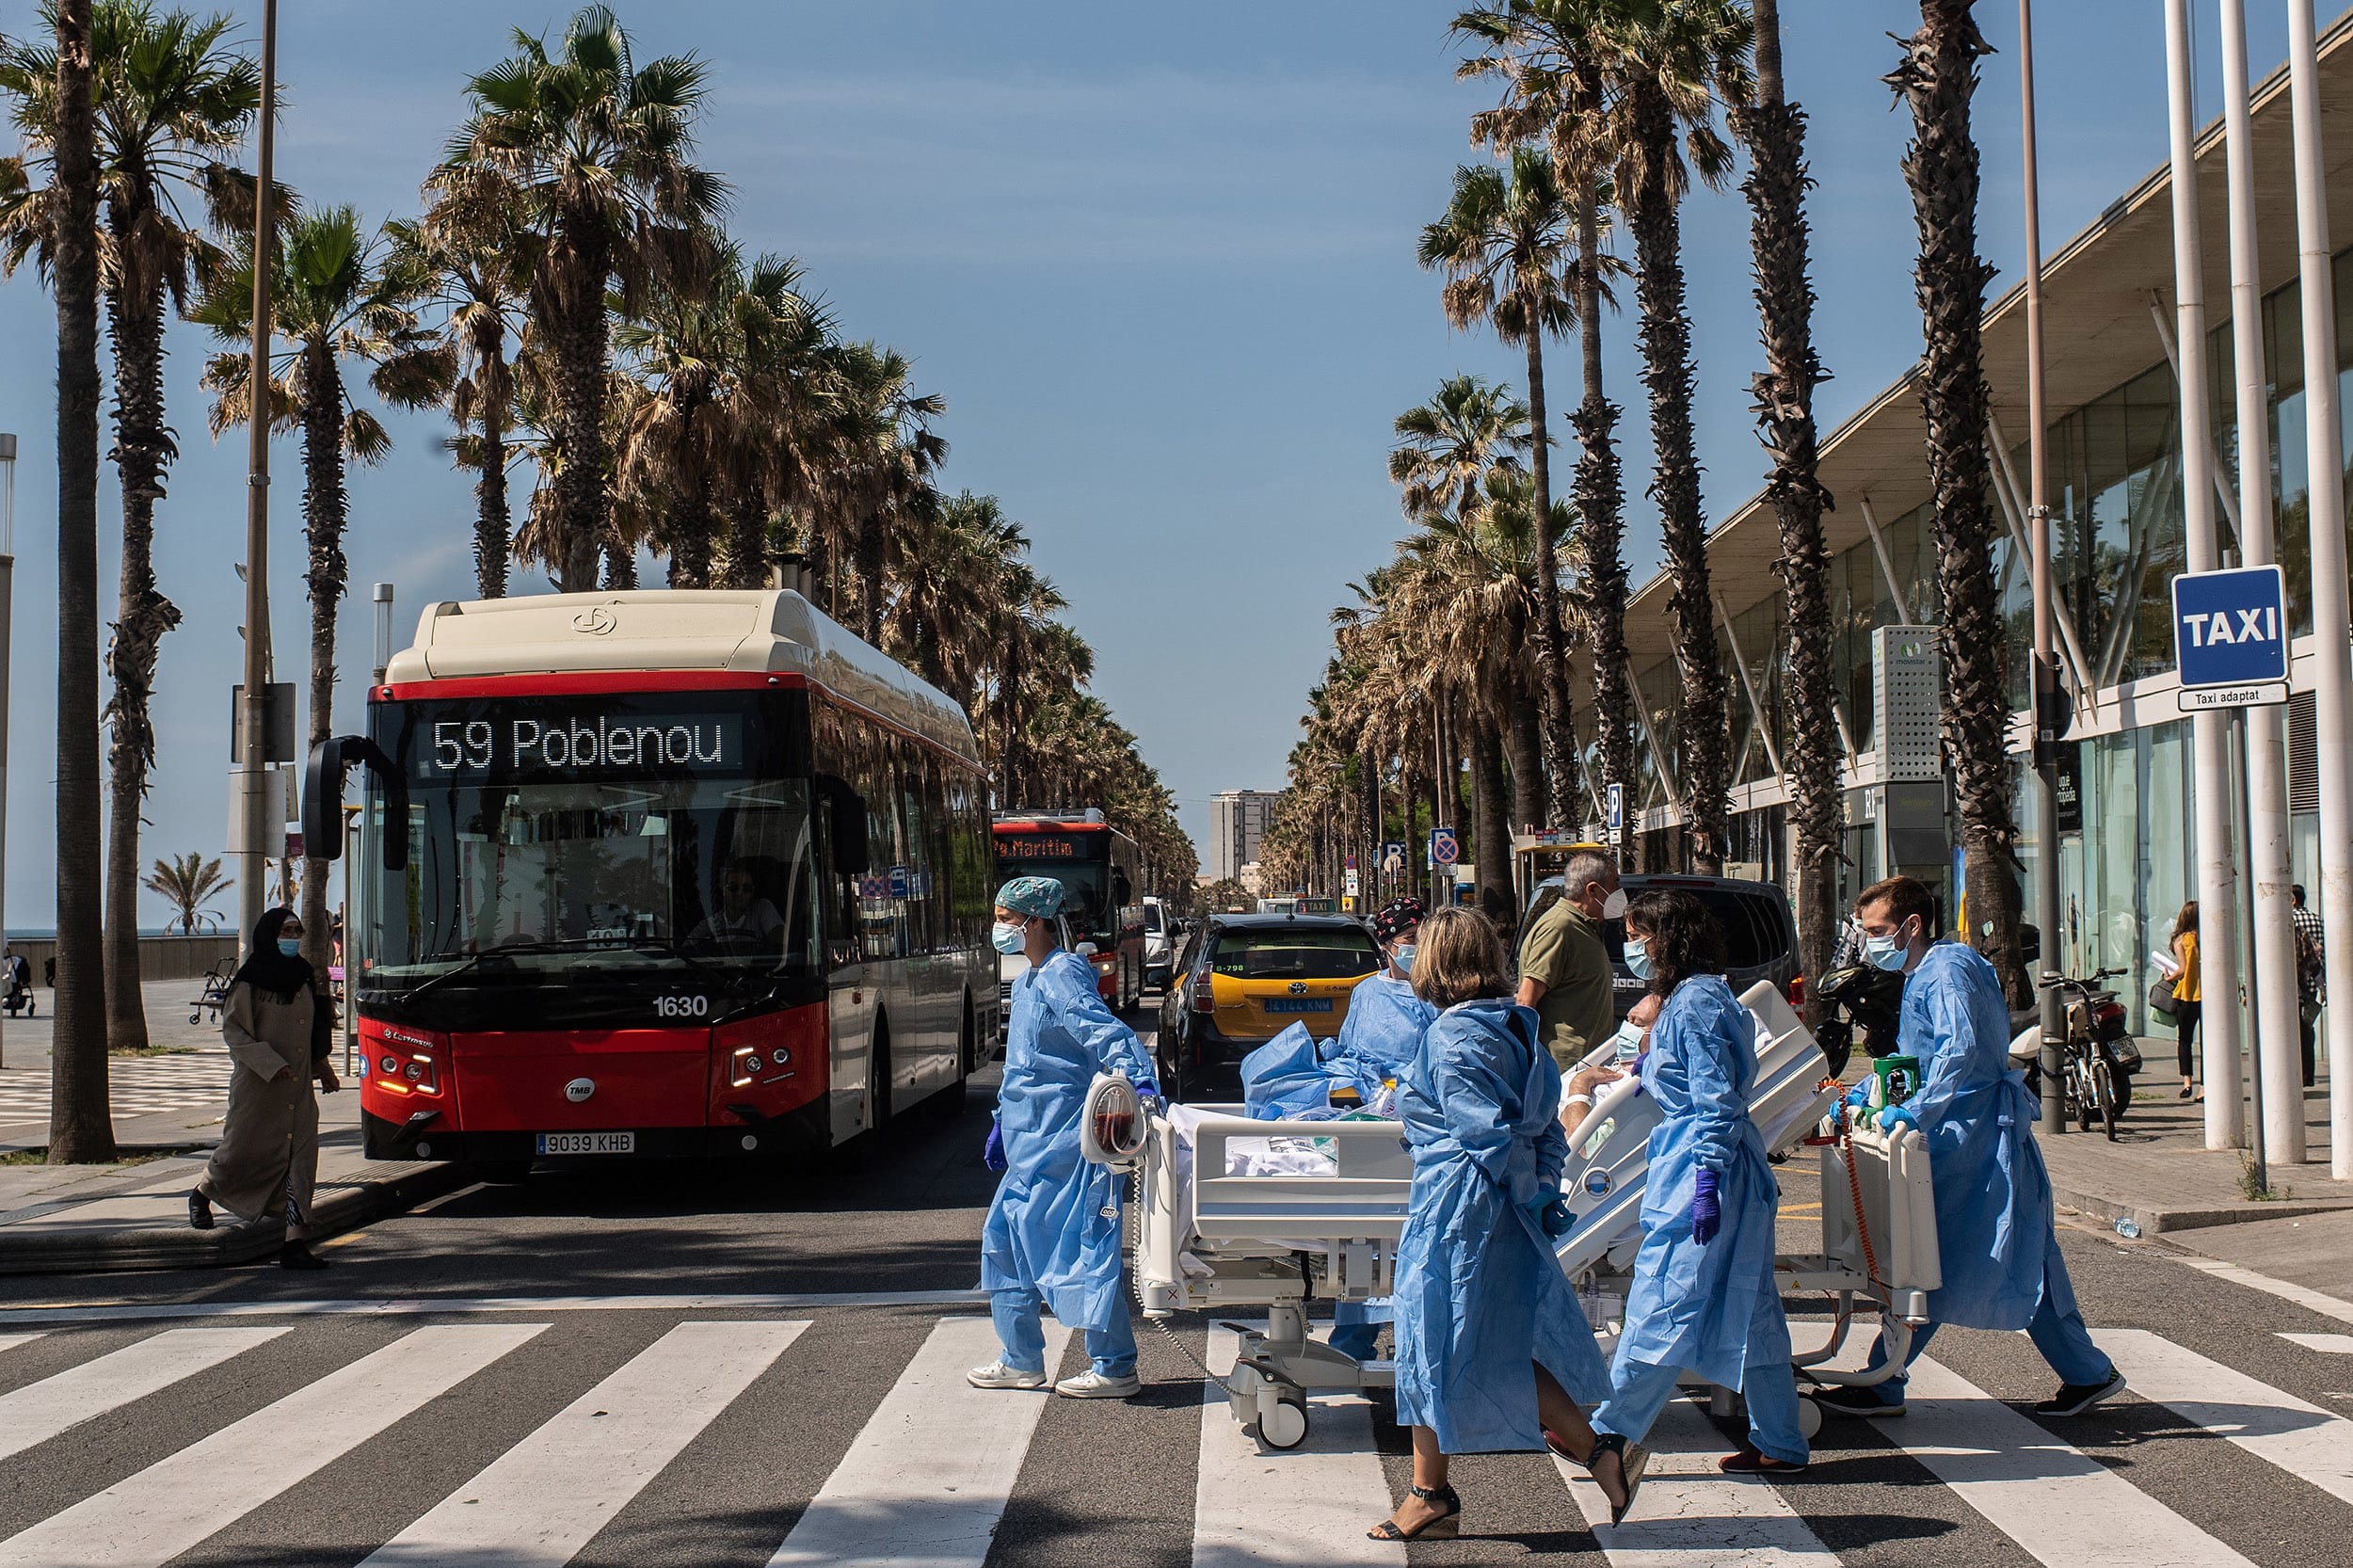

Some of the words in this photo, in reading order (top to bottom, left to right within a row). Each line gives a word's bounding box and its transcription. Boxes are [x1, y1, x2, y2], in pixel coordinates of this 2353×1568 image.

[2183, 607, 2277, 648] TAXI
[2196, 693, 2217, 704] Taxi
[2220, 691, 2260, 703] adaptat
[435, 721, 492, 769] 59
[513, 715, 722, 768] Poblenou
[1610, 790, 1619, 824] P
[1308, 903, 1327, 912] TAXI
[652, 996, 708, 1016] 1630
[549, 1136, 592, 1152] 9039
[598, 1134, 631, 1151] KHB
